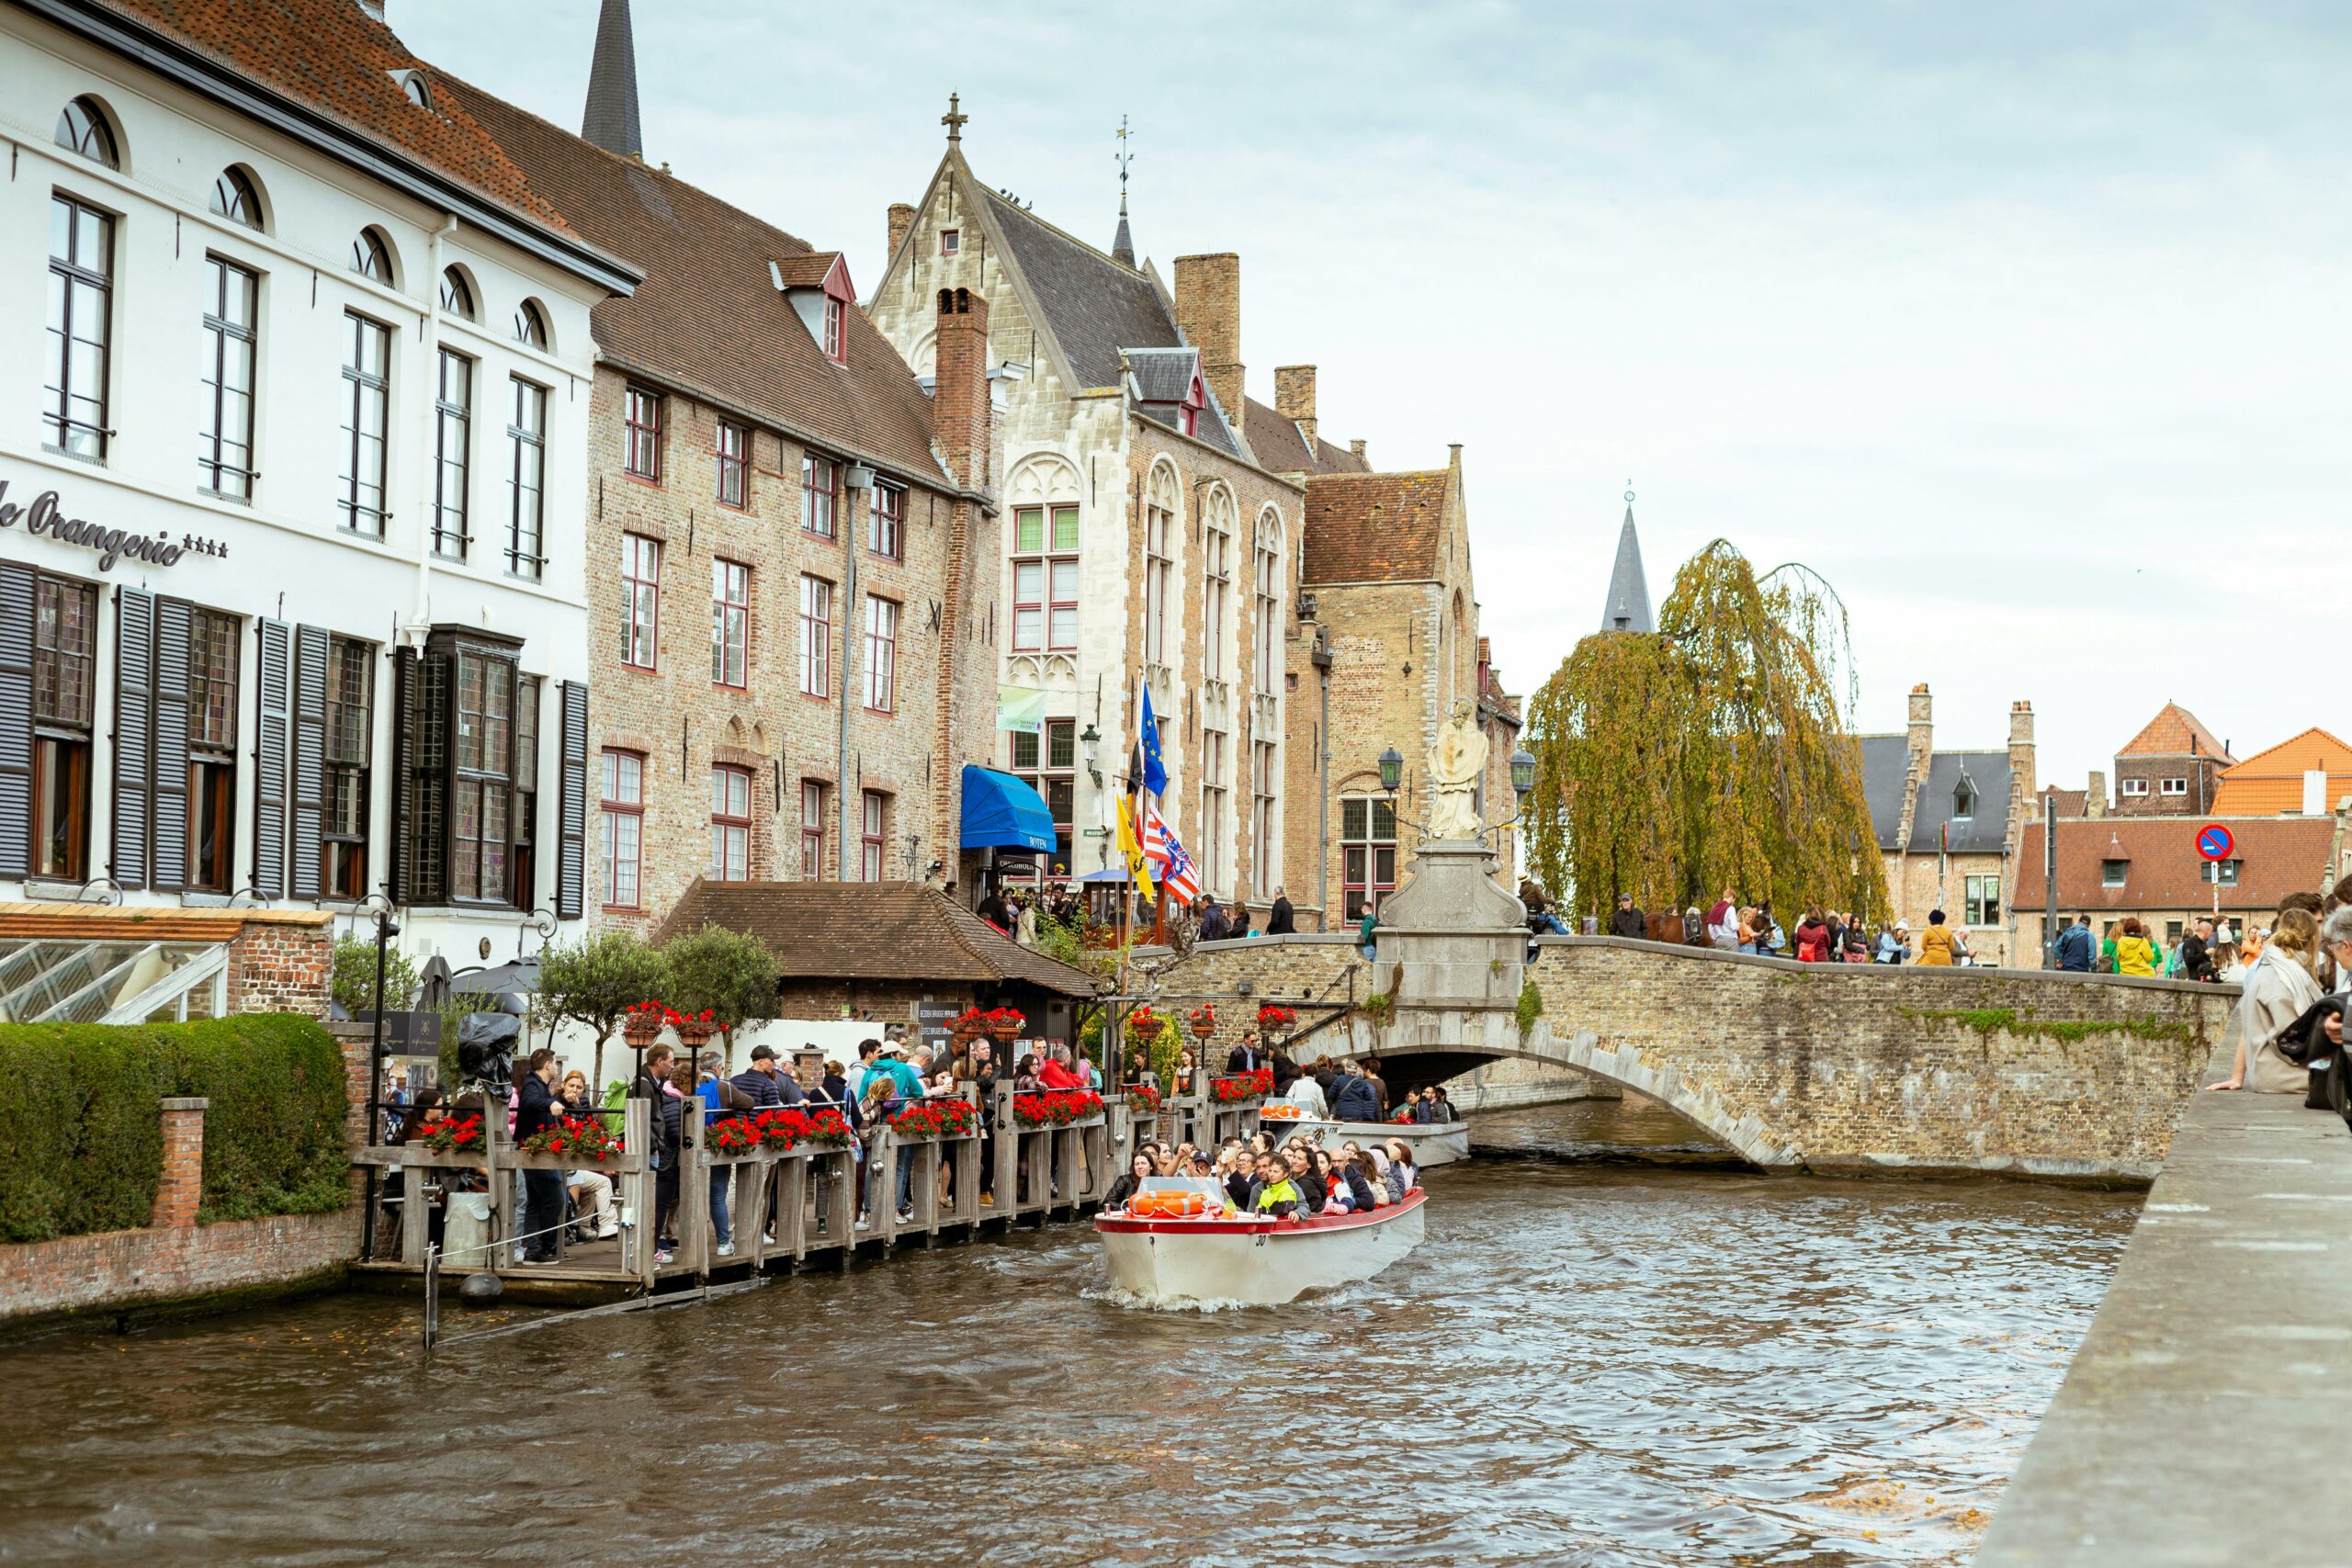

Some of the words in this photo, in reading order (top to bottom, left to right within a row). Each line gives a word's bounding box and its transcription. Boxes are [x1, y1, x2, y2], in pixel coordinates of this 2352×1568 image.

[28, 491, 187, 572] Orangerie
[1029, 837, 1046, 849] BOTEN
[1256, 1235, 1266, 1247] 30
